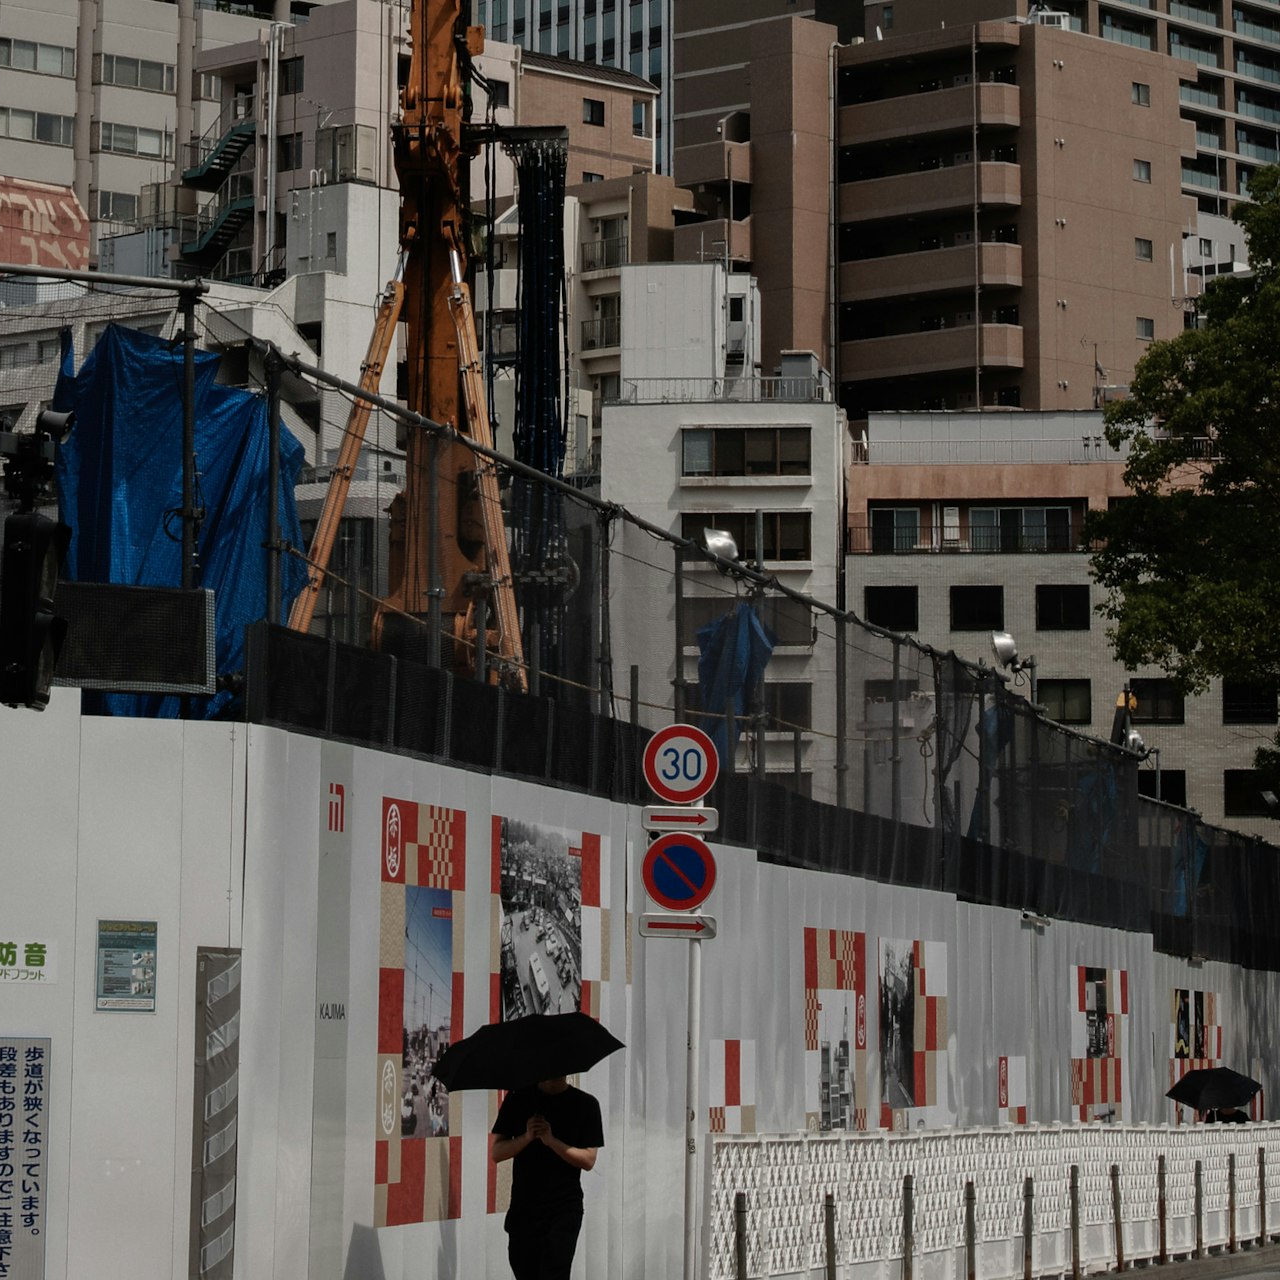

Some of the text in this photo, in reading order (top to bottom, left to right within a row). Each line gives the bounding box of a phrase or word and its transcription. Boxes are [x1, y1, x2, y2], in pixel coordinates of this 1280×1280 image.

[662, 748, 701, 781] 30
[319, 1003, 346, 1020] KAJIMA
[20, 1046, 45, 1236] 歩道が狭くなっています。
